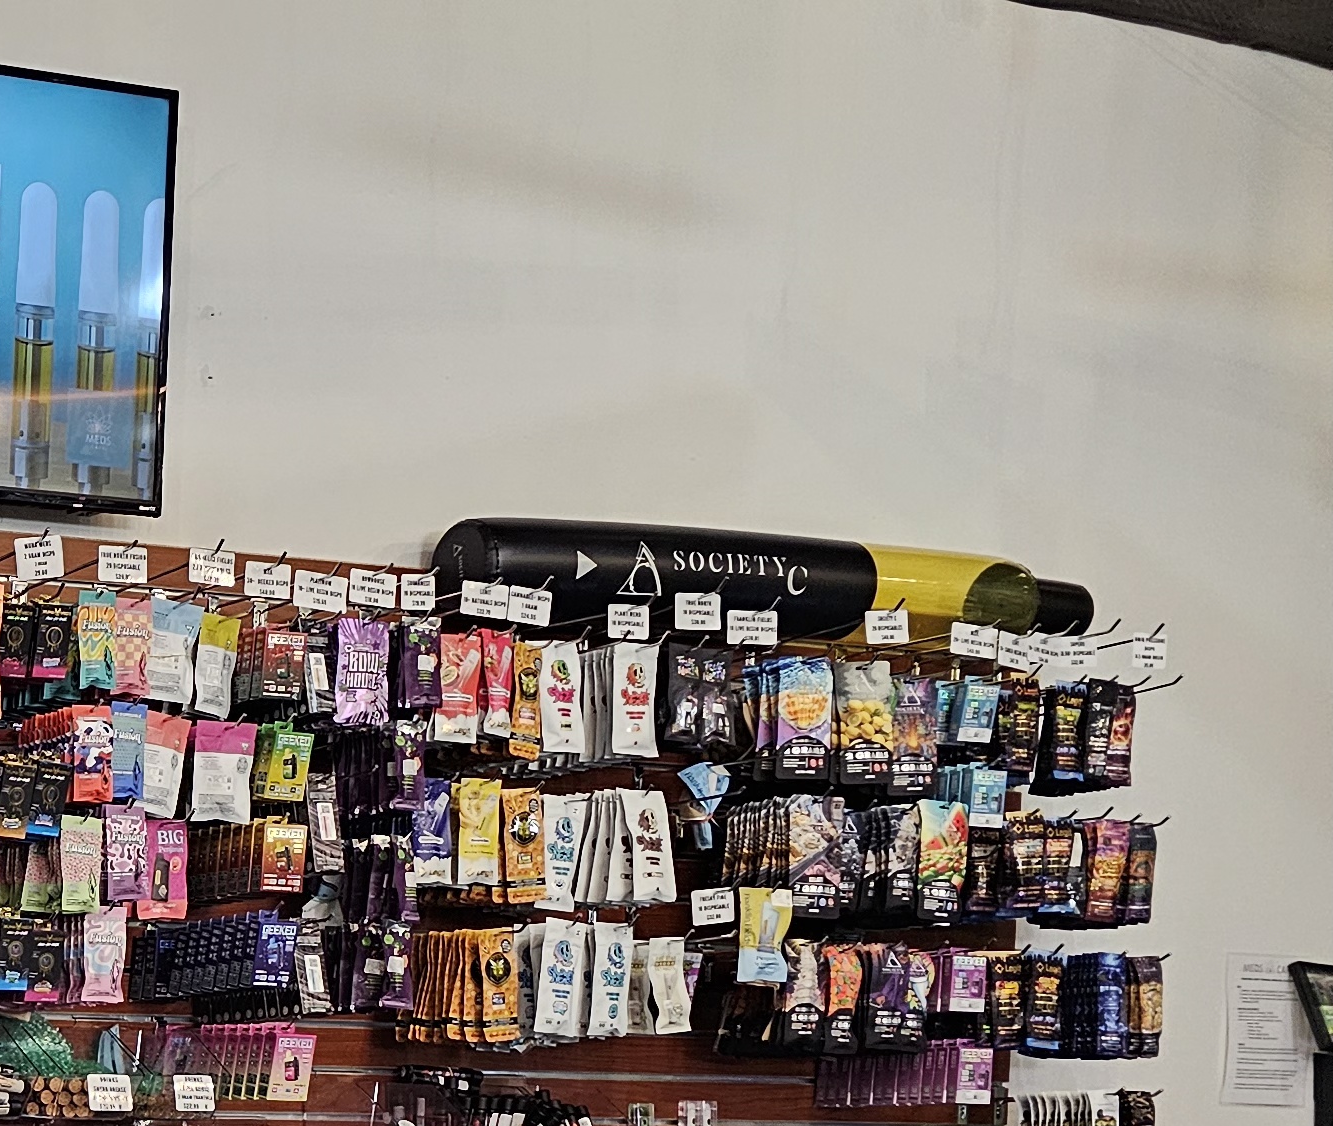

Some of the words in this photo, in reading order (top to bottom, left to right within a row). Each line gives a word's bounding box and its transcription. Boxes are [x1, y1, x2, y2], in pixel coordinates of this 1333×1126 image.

[672, 549, 787, 578] SOCIETY
[787, 565, 808, 596] C
[268, 635, 305, 646] GEEKED
[348, 651, 381, 673] BOW
[345, 671, 381, 690] HOUSE
[156, 829, 185, 844] BIG
